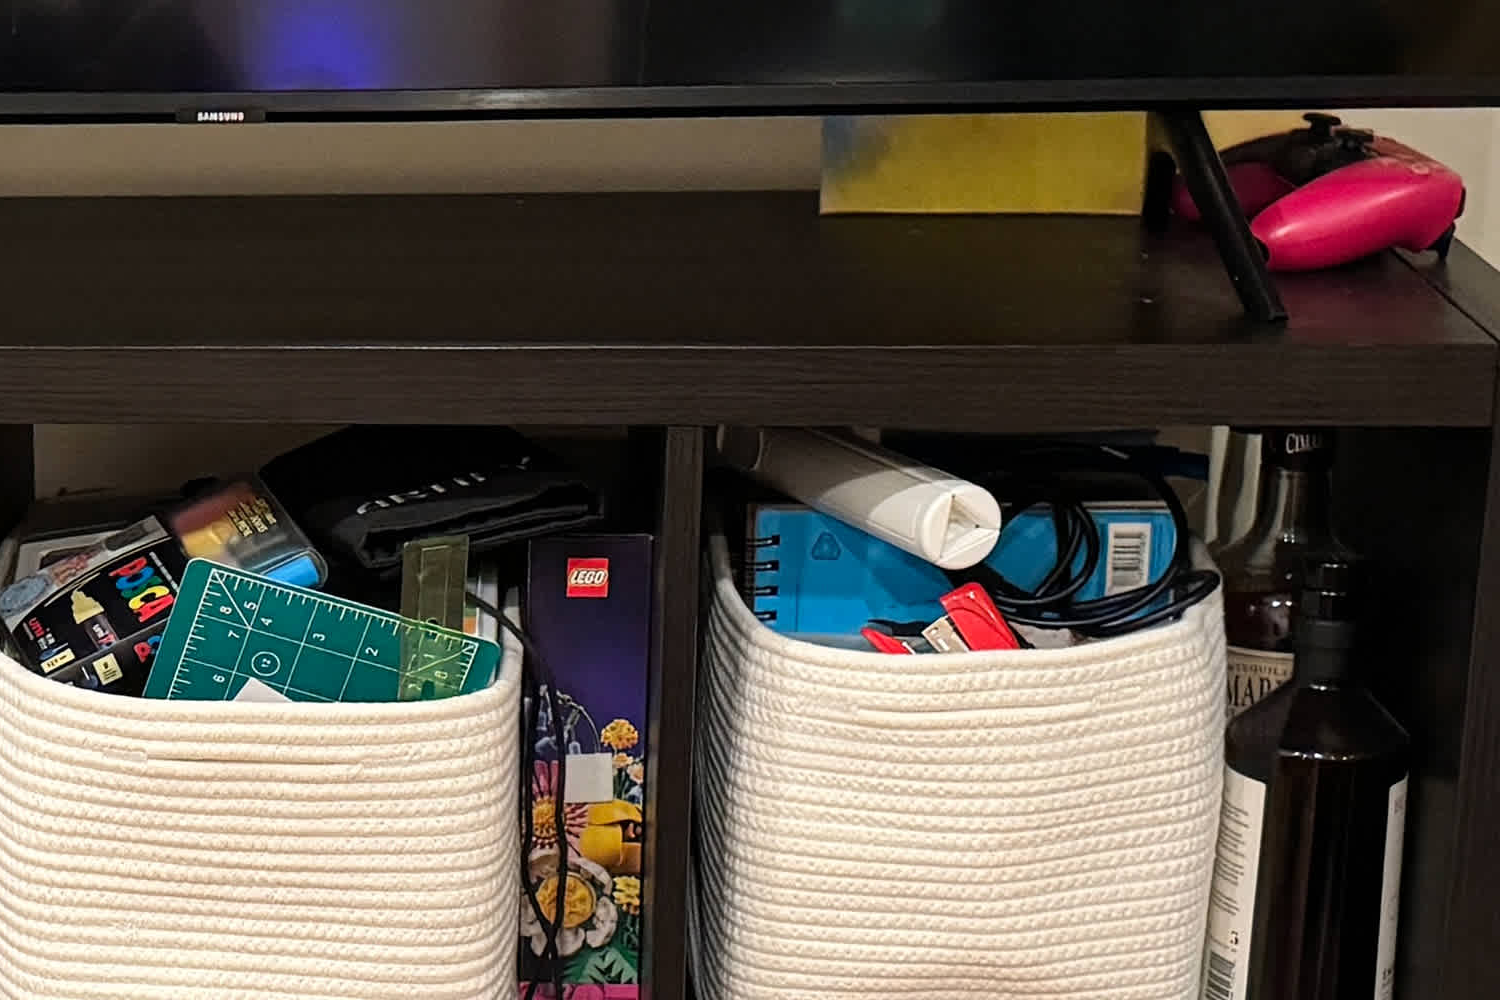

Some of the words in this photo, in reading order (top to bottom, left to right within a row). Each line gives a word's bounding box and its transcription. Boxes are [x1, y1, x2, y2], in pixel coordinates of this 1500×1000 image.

[197, 111, 244, 121] SAMSUNG
[570, 570, 606, 586] LEGO
[108, 556, 176, 623] POSCA
[312, 632, 327, 643] 3
[365, 646, 379, 658] 2
